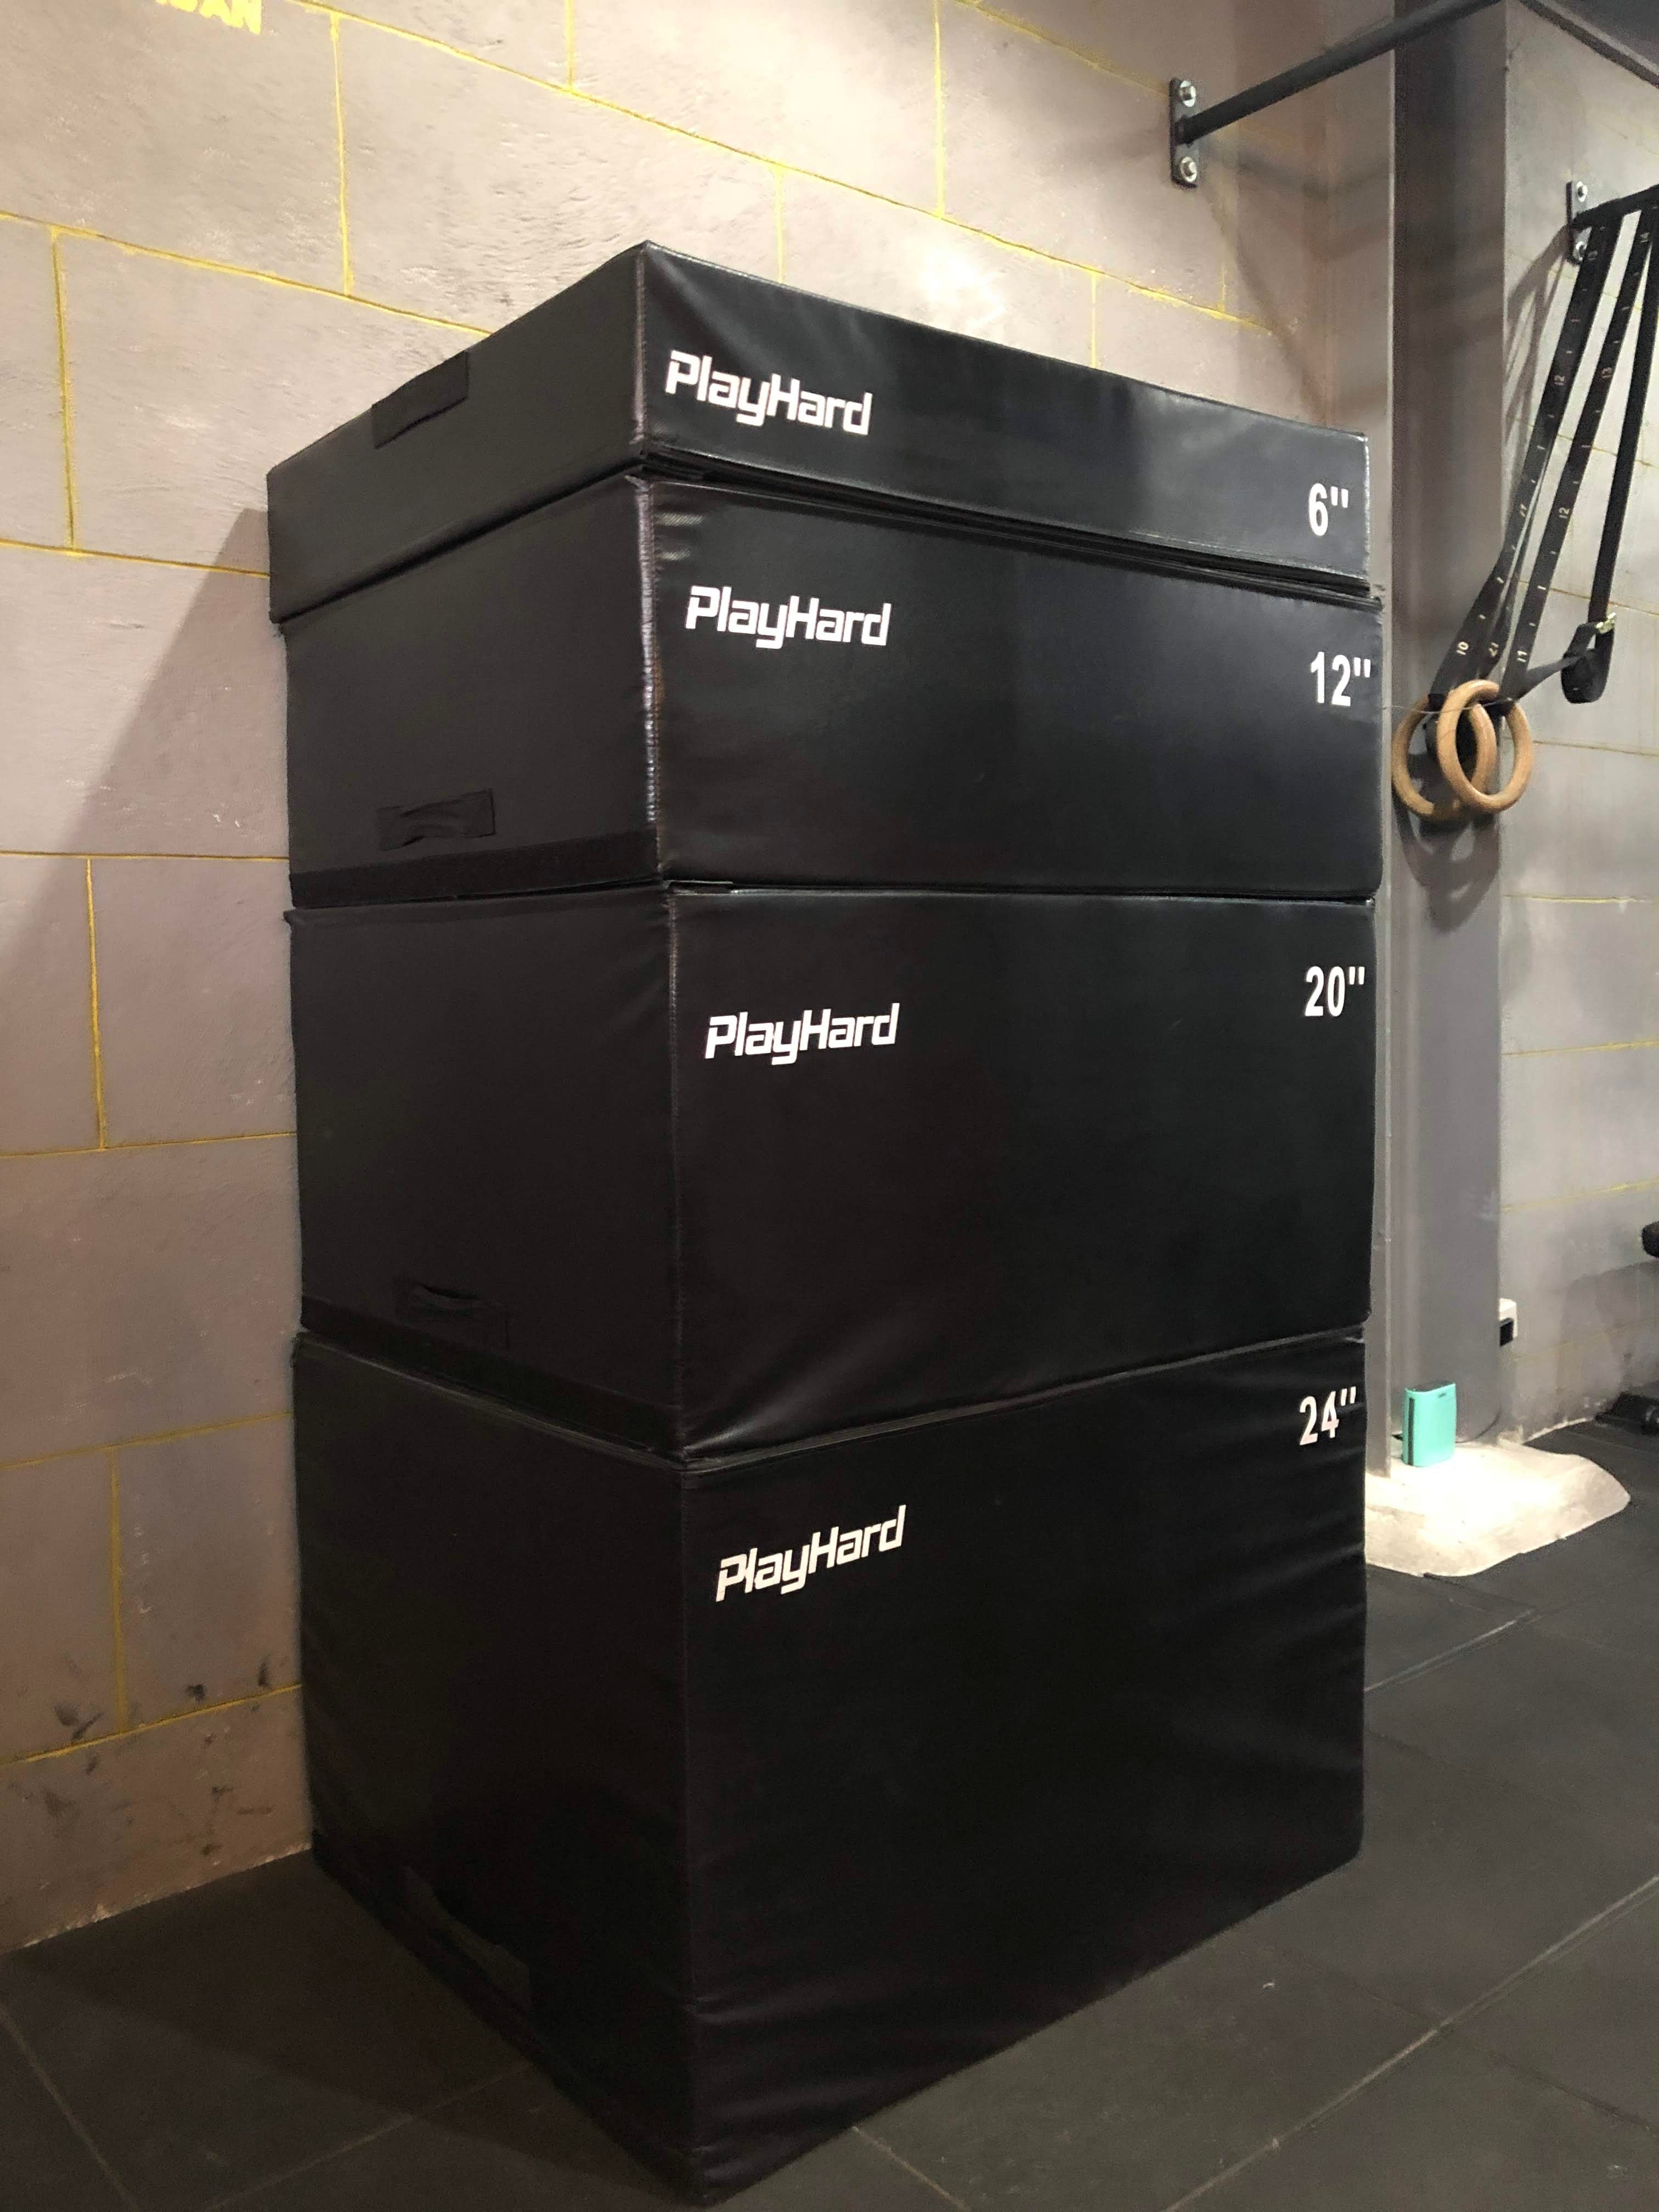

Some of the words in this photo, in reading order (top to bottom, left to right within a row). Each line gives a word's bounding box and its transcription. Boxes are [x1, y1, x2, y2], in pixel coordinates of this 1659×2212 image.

[665, 350, 872, 435] PlayHard
[1554, 375, 1565, 386] 12
[1308, 483, 1349, 536] 6"
[1559, 507, 1570, 518] 12
[686, 585, 891, 649] PlayHard
[1456, 641, 1469, 656] 10
[1310, 651, 1371, 707] 12"
[1305, 966, 1365, 1017] 20"
[705, 1003, 900, 1065] PlayHard
[1300, 1386, 1356, 1446] 24"
[716, 1504, 906, 1602] PlayHard
